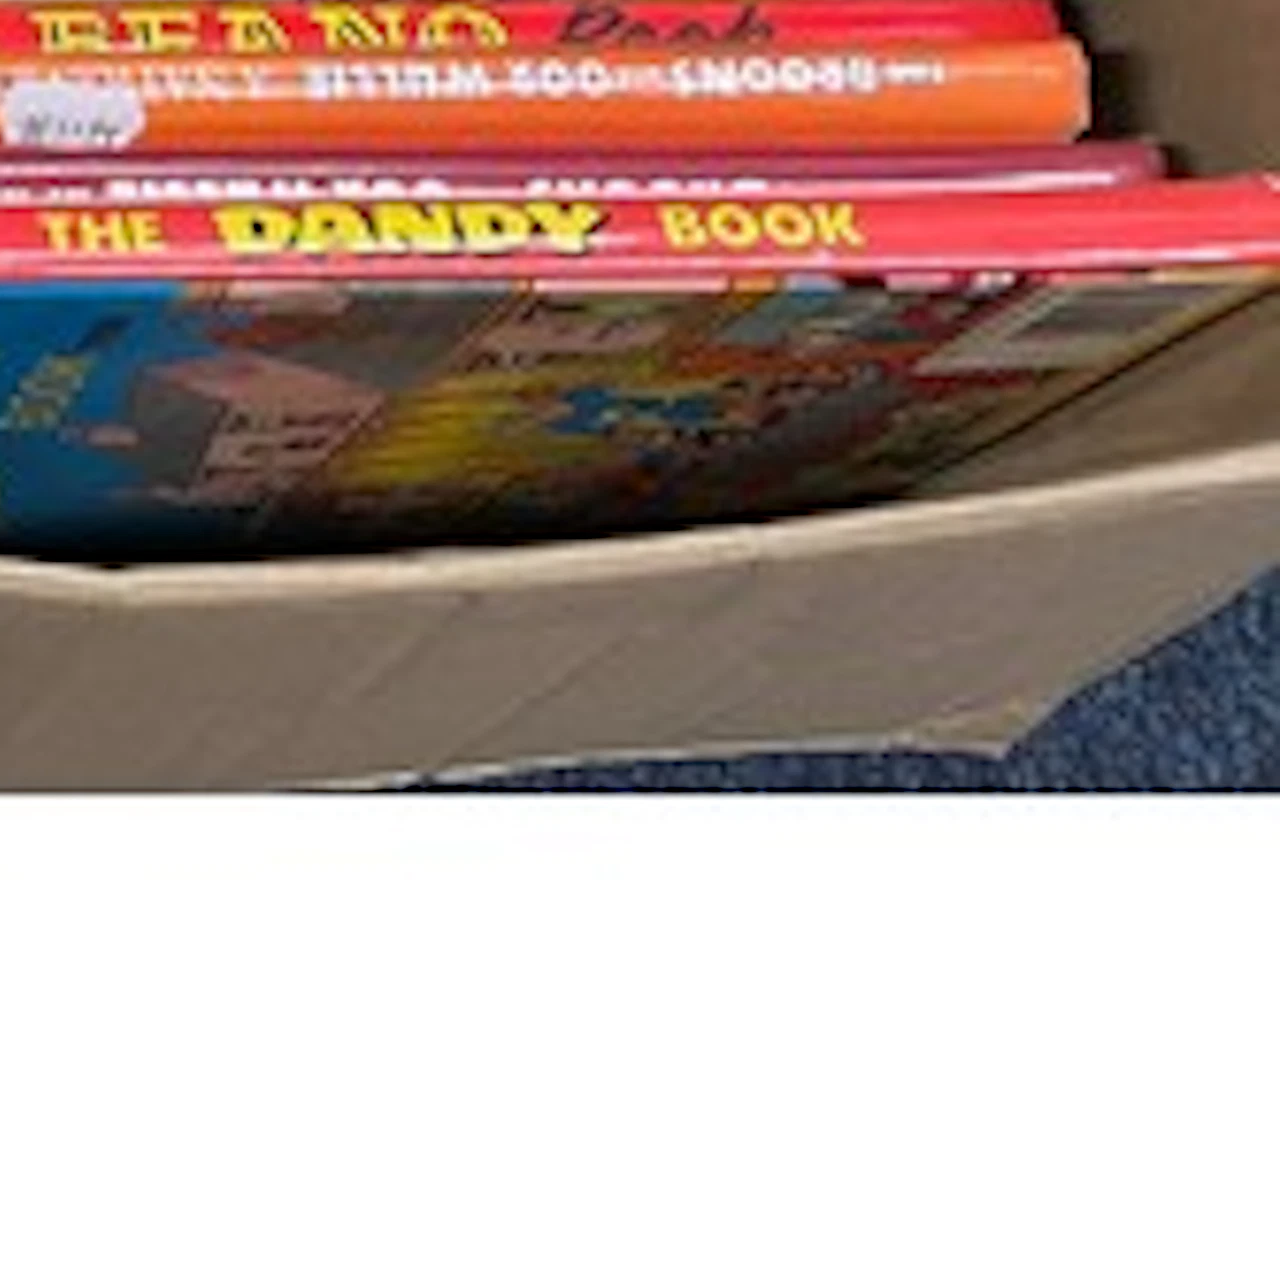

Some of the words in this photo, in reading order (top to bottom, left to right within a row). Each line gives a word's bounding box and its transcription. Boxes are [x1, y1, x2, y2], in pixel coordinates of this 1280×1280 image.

[28, 4, 509, 55] BEANO
[300, 60, 494, 100] WULLIE
[668, 60, 881, 96] BROONS
[40, 210, 163, 254] THE
[213, 200, 608, 256] DANDY
[658, 202, 866, 251] BOOK
